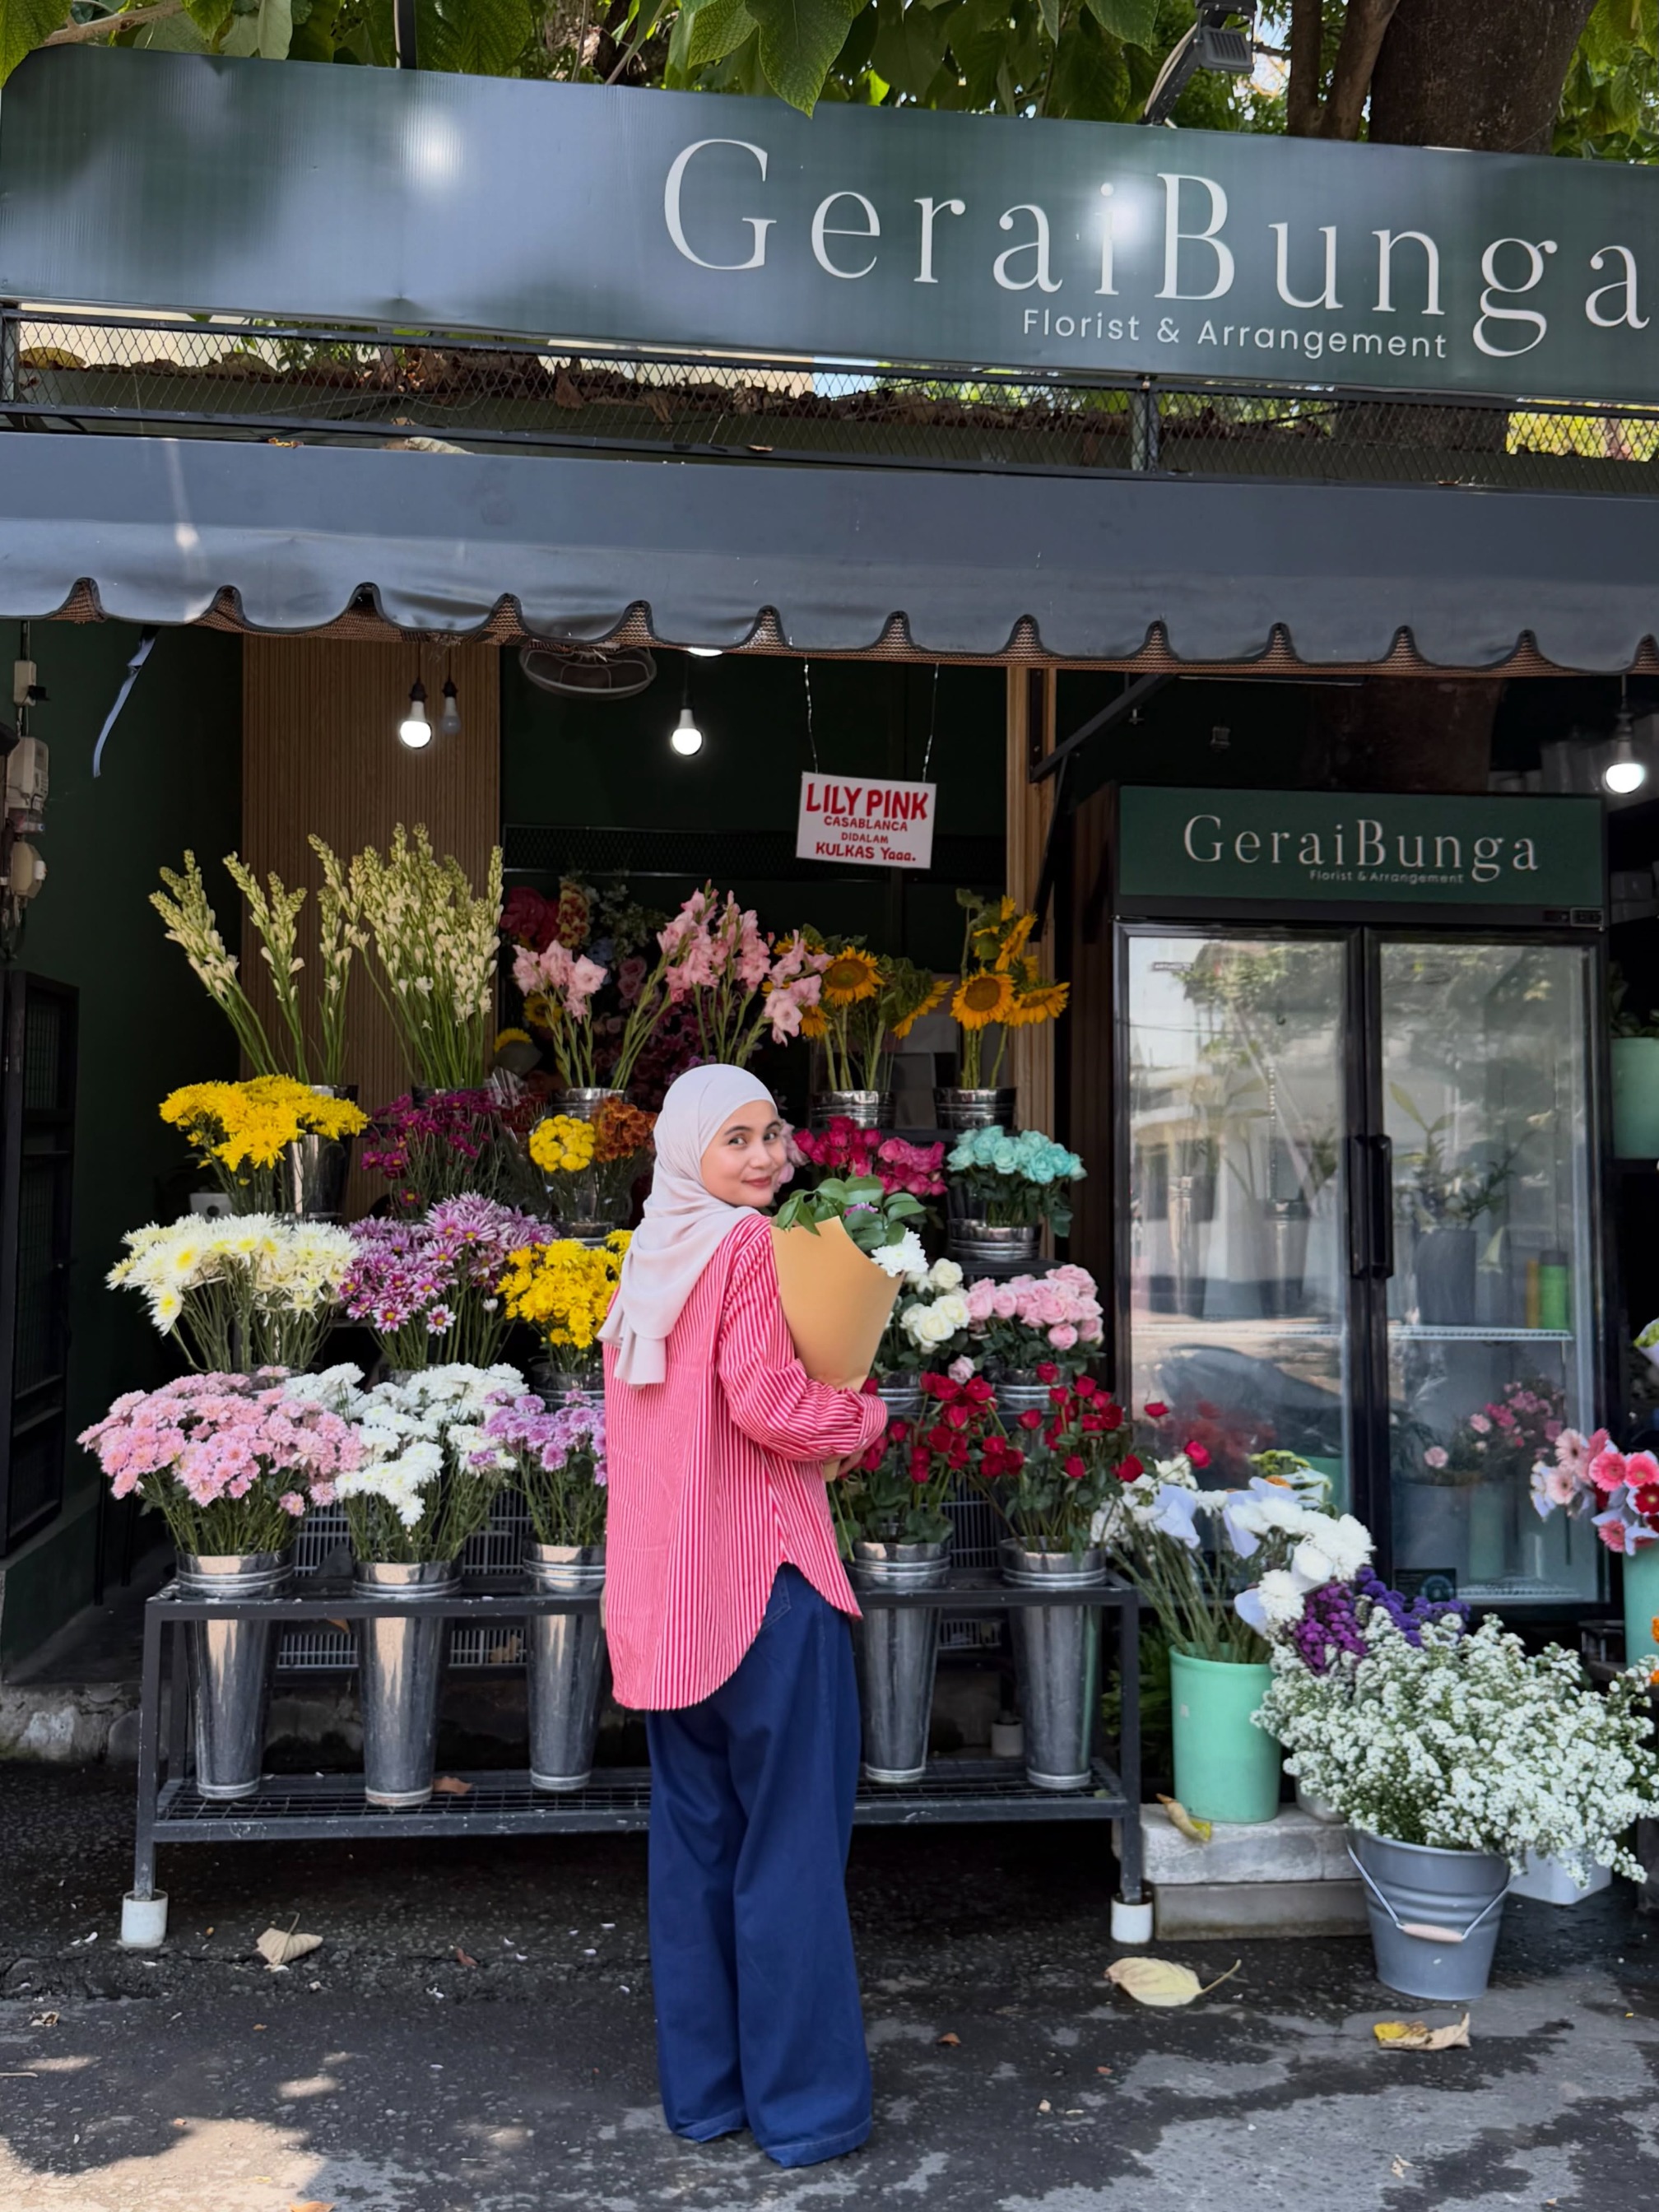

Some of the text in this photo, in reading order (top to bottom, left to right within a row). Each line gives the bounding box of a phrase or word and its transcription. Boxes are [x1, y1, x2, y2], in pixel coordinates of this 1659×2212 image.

[1023, 309, 1447, 360] Florist & Arrangement
[806, 783, 929, 820] LILY PINK
[824, 816, 908, 832] CASABLANCA
[841, 832, 889, 844] DIDALAM
[816, 842, 917, 862] KULKAS Yaaa.
[1309, 870, 1465, 885] Florist & Arrangement
